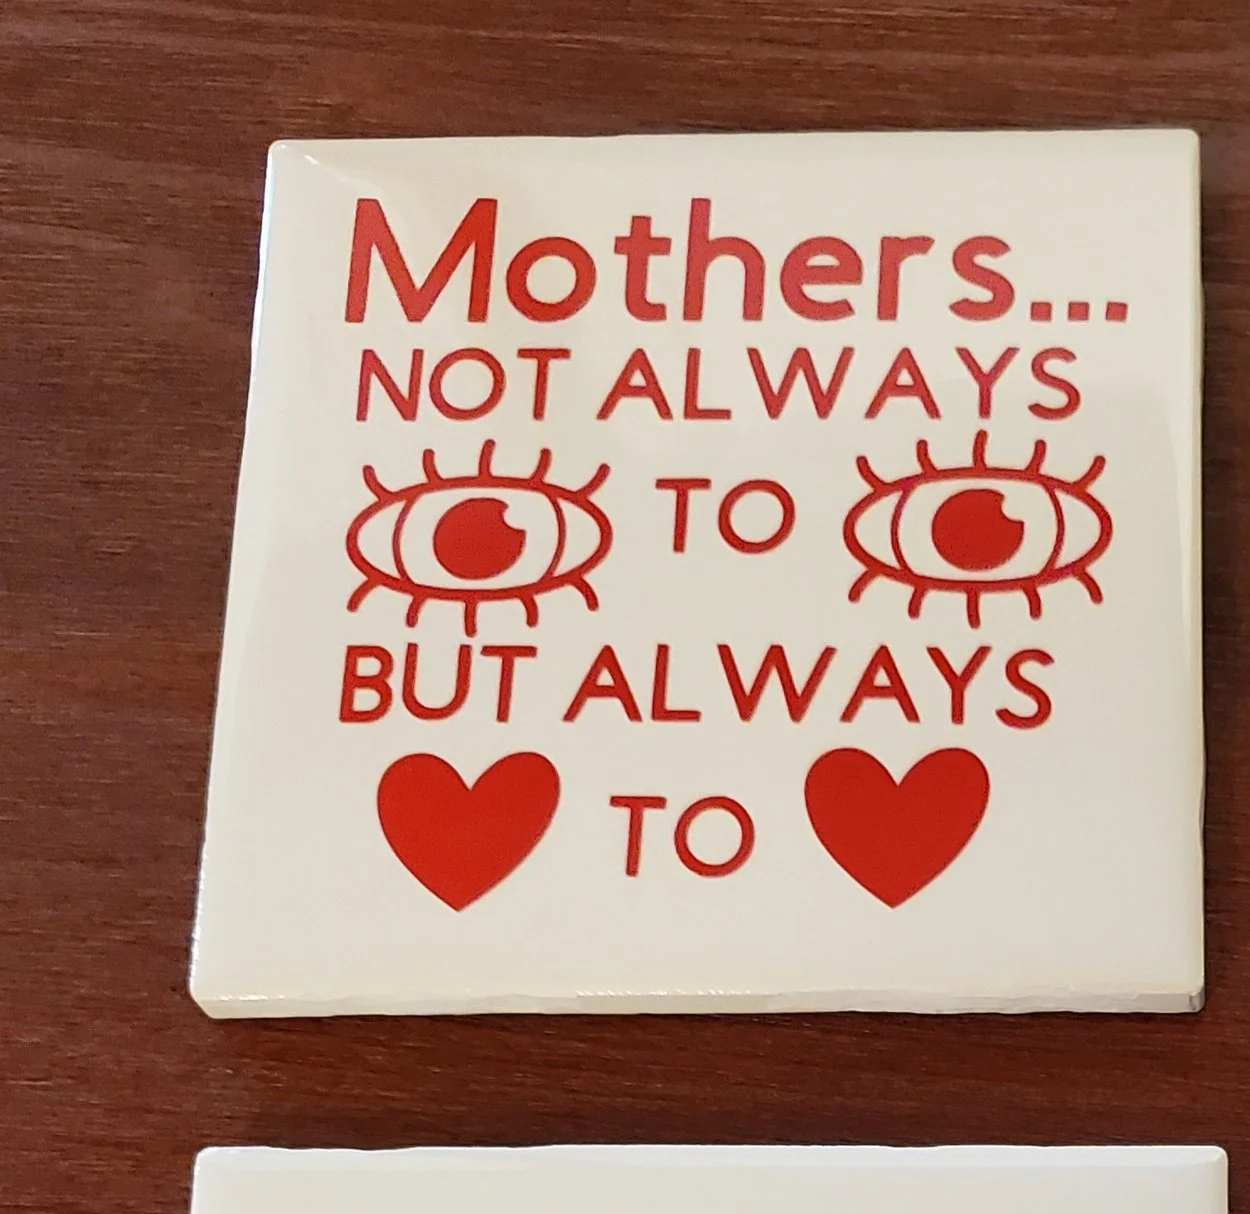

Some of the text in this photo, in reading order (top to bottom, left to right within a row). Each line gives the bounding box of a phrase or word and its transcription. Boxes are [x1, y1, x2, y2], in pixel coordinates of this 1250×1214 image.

[344, 196, 1129, 324] Mothers...
[355, 345, 1082, 423] NOT ALWAYS
[654, 476, 797, 556] TO
[337, 641, 1055, 731] BUT ALWAYS
[608, 794, 756, 879] TO
